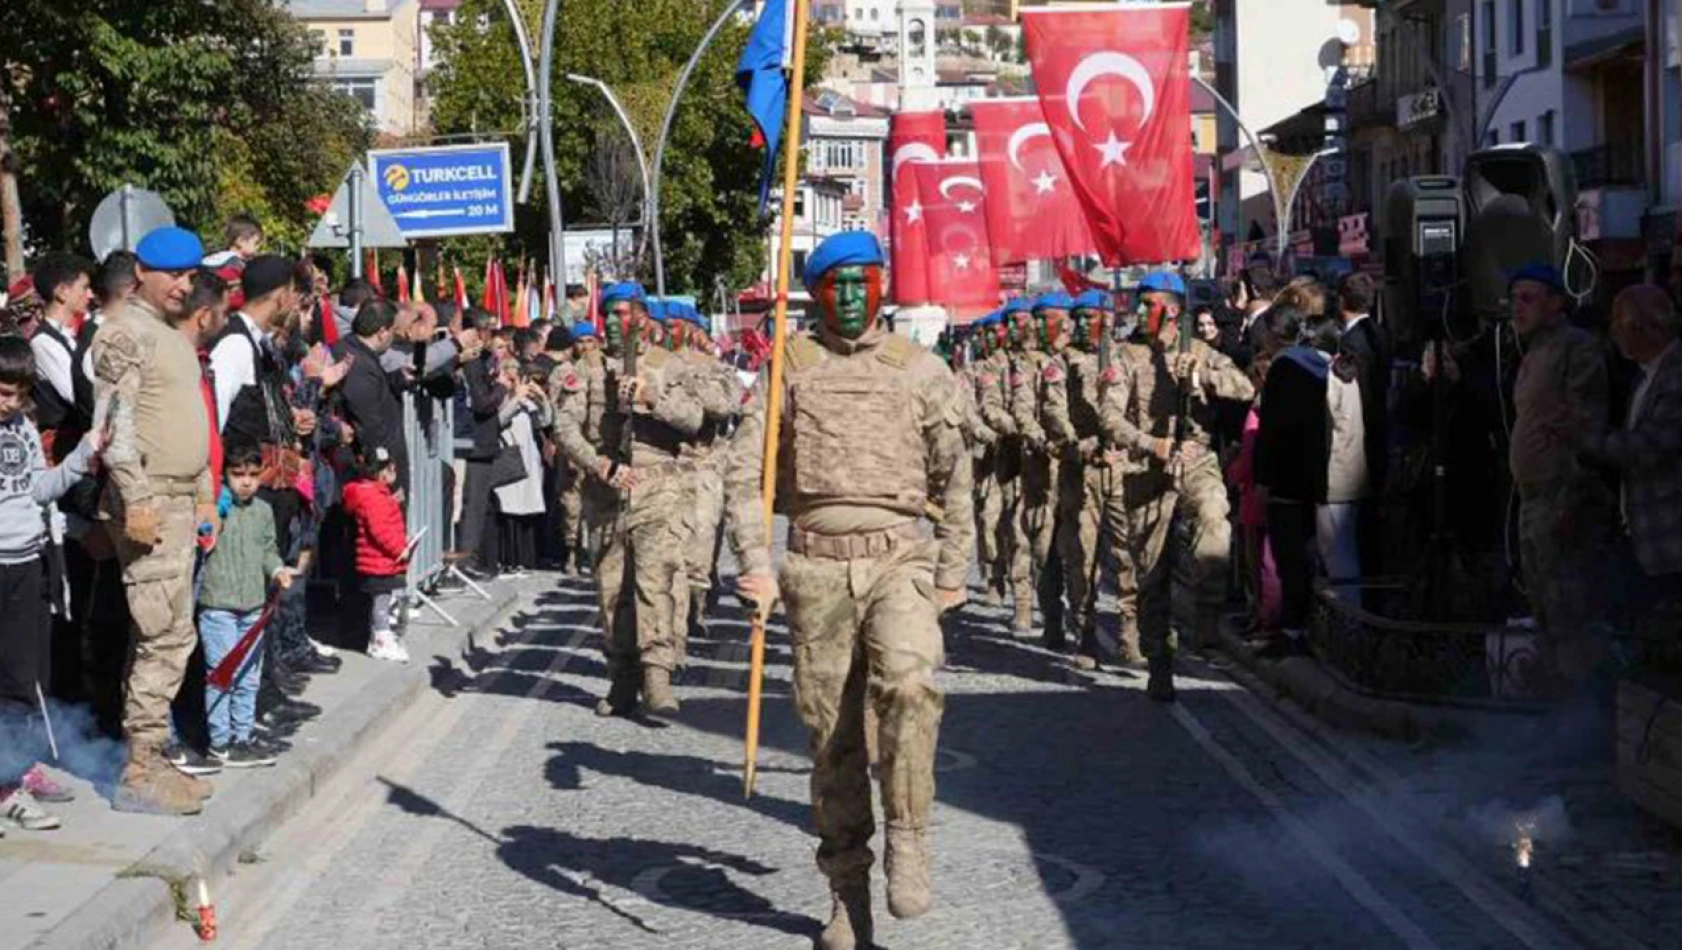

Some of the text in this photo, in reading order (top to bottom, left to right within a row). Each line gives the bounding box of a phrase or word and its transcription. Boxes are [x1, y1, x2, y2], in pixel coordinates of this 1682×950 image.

[411, 165, 497, 183] TURKCELL
[467, 204, 498, 217] 20 M
